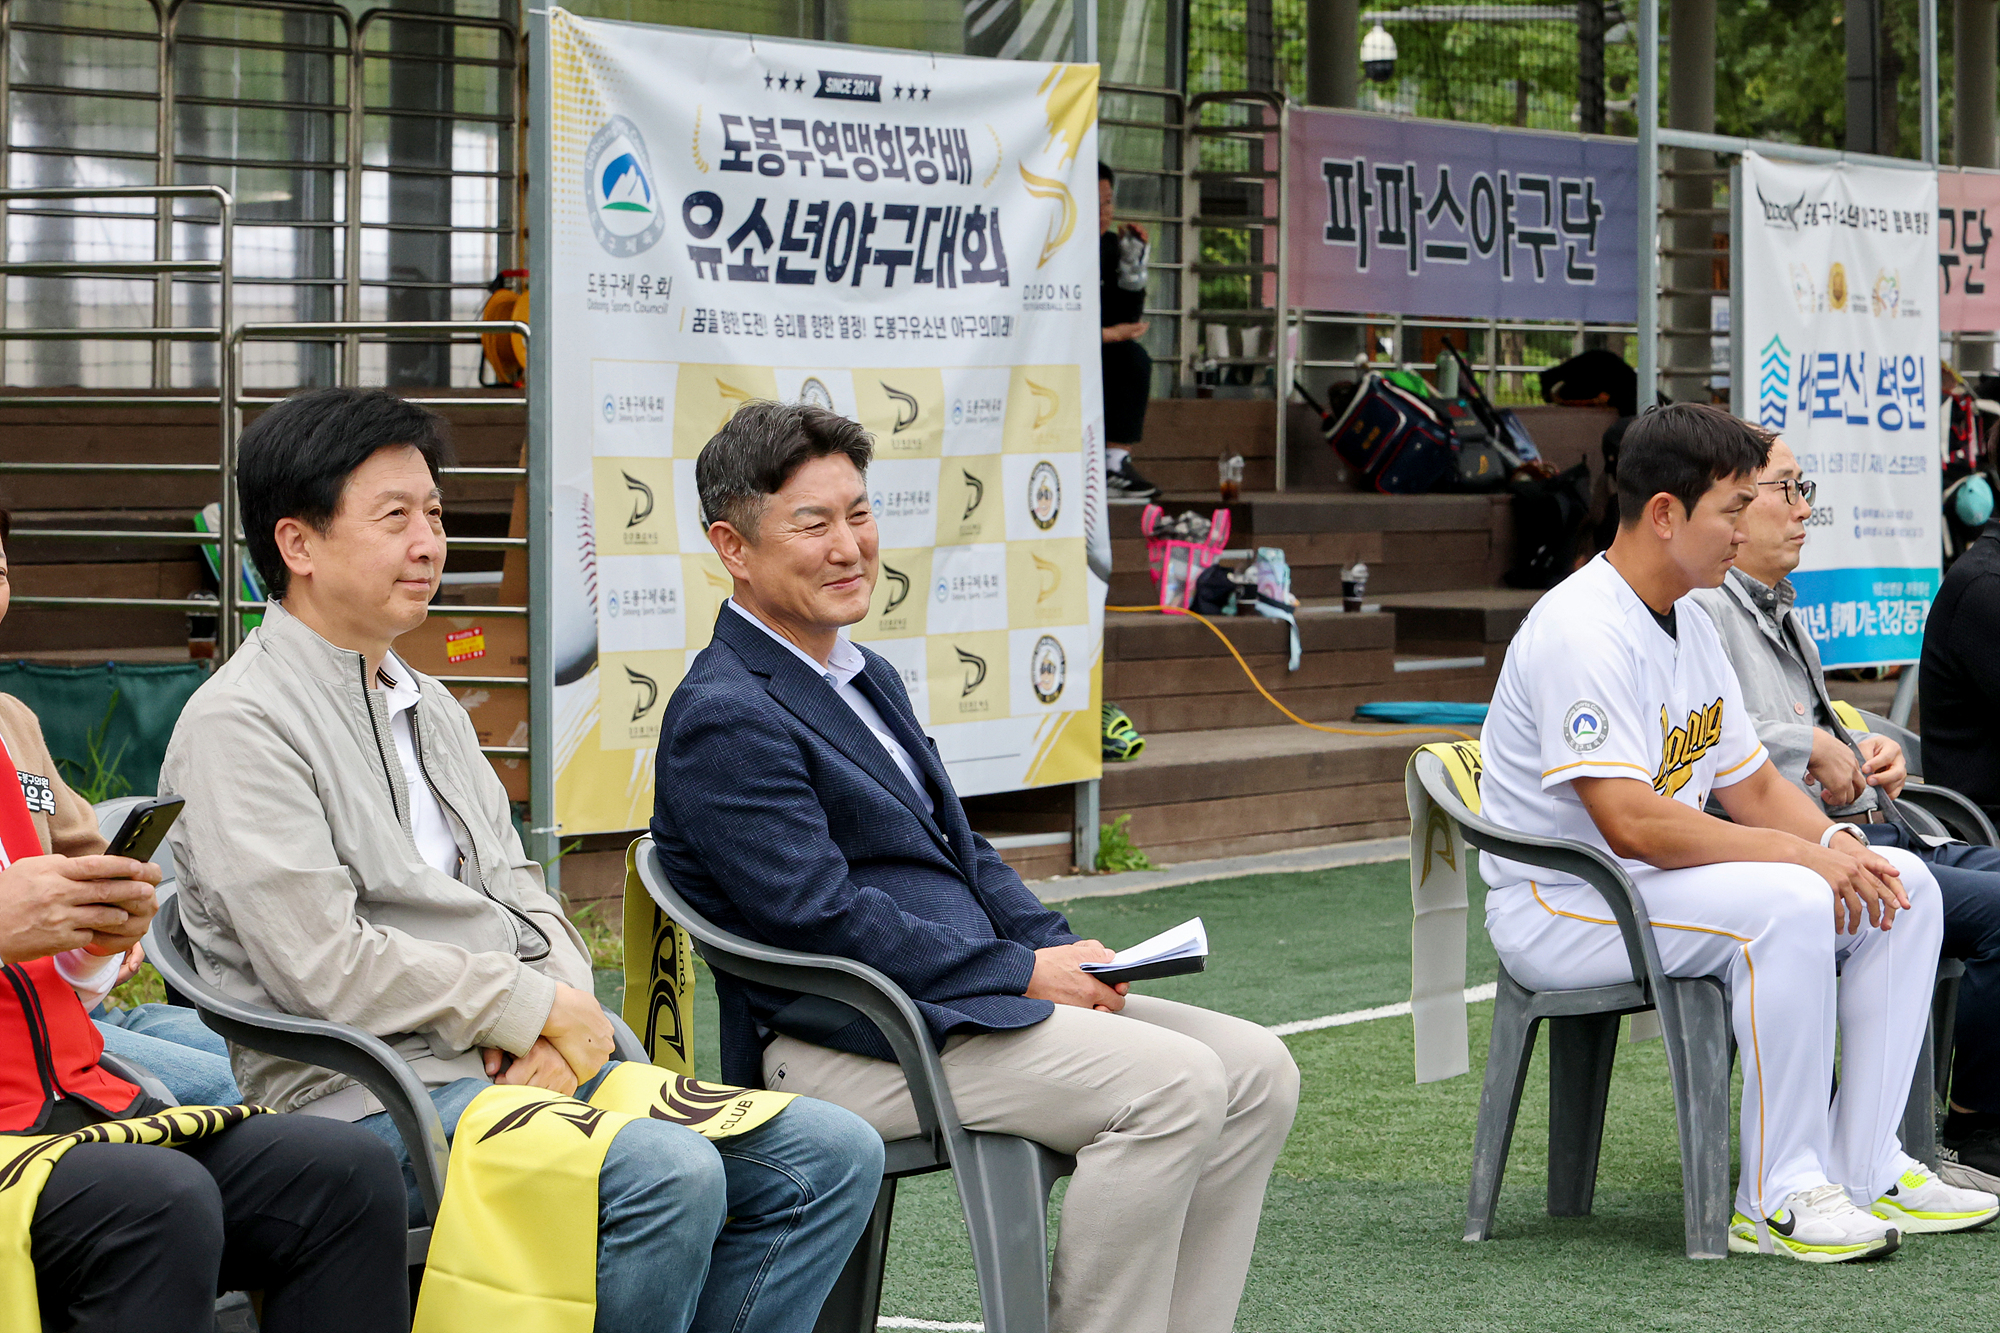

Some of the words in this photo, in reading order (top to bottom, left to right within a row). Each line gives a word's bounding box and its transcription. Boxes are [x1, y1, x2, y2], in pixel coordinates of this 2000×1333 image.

[825, 76, 852, 95] SINCE
[852, 79, 875, 96] 2014
[718, 113, 972, 185] 도봉구연맹회장배
[1321, 156, 1605, 285] 파파스야구단
[682, 190, 1010, 289] 유소년야구대회
[587, 273, 673, 300] 도봉구체육회
[634, 300, 669, 314] Council
[692, 308, 719, 334] 꿈을
[721, 310, 741, 335] 향한
[774, 313, 808, 339] 승리를
[811, 315, 834, 339] 향한
[838, 315, 867, 340] 열정!
[874, 315, 947, 340] 도봉구유소년
[678, 932, 686, 998] YOUTH
[720, 1100, 753, 1130] CLUB
